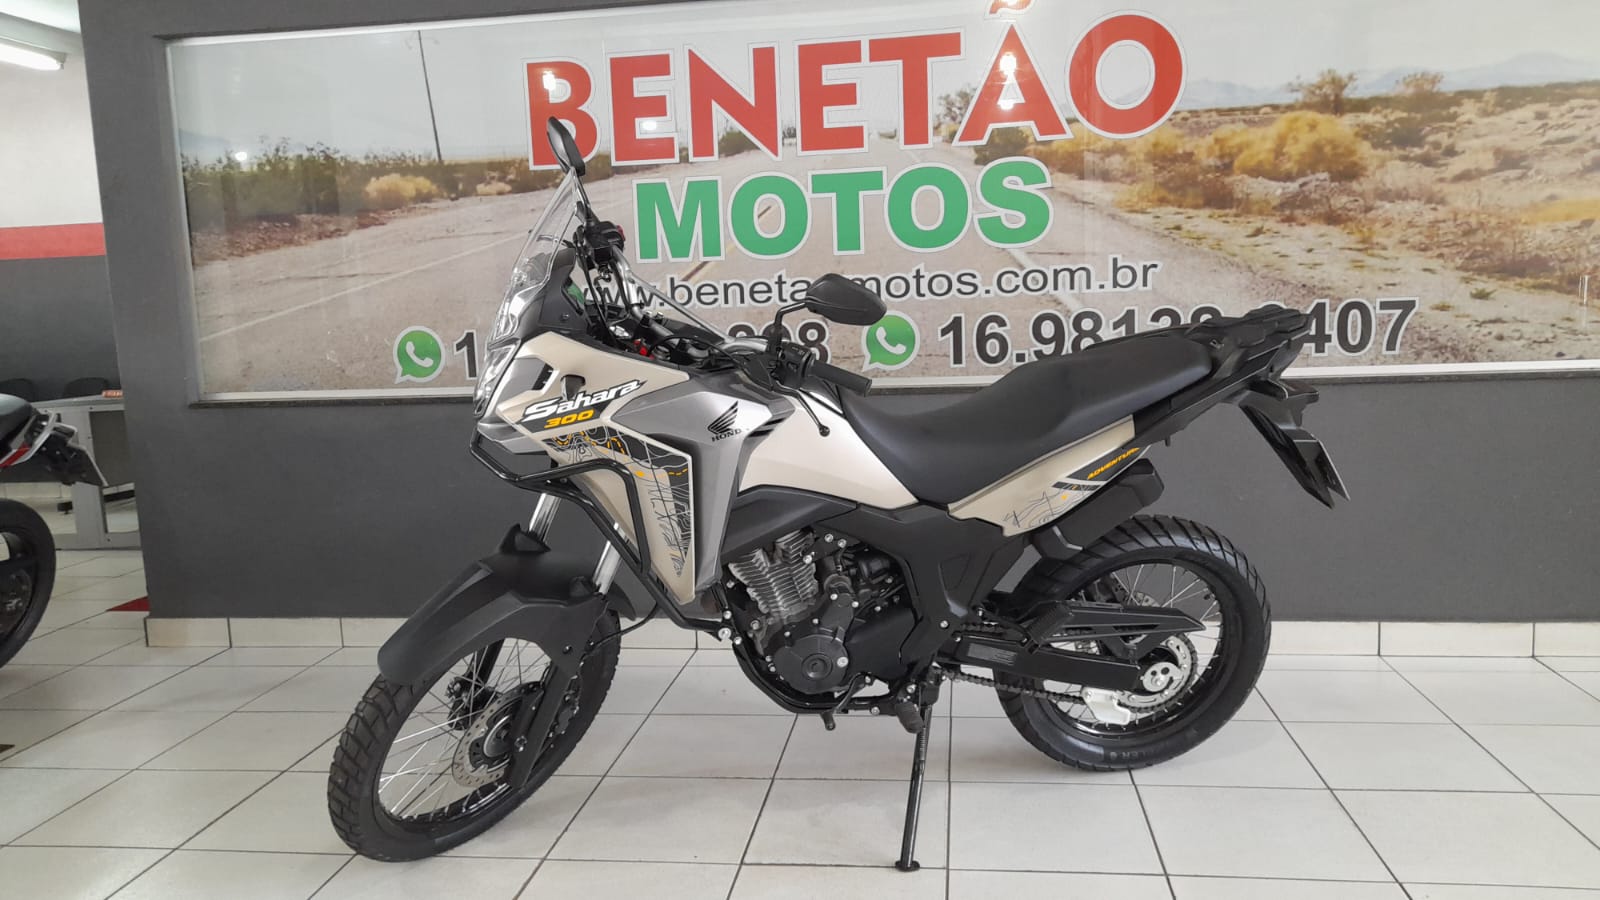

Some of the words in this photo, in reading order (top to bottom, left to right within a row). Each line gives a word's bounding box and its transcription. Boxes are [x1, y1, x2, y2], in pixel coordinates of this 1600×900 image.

[526, 0, 1184, 167] BENETÃO
[635, 160, 1052, 260] MOTOS
[520, 380, 641, 422] Sahara
[543, 409, 595, 429] 300
